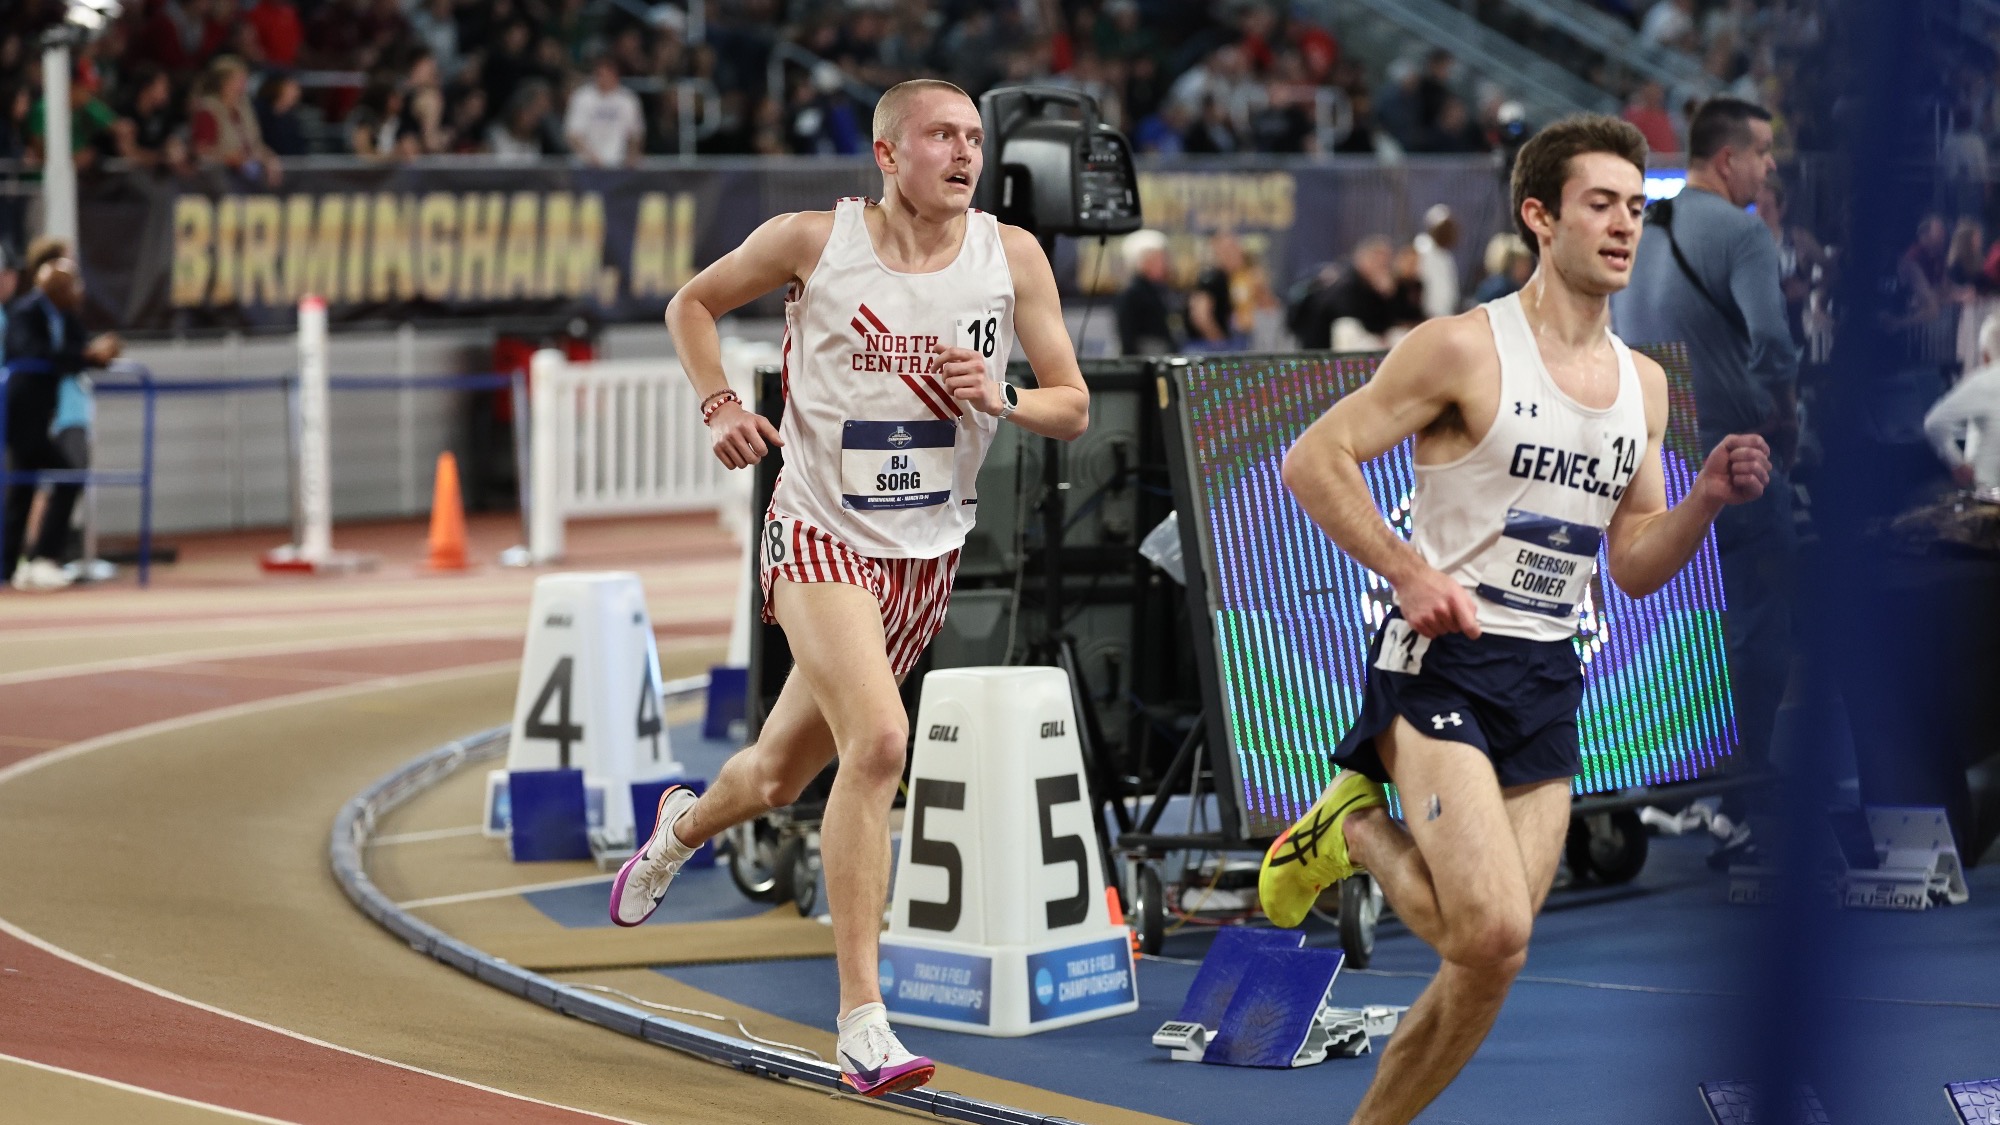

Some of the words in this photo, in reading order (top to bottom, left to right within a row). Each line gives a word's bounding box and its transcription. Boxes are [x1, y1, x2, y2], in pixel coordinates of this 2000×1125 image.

[172, 192, 620, 307] BIRMINGHAM,
[631, 189, 698, 299] AL
[865, 334, 939, 353] NORTH
[967, 317, 997, 358] 18
[891, 455, 908, 470] BJ
[1509, 443, 1626, 501] GENES
[1612, 436, 1636, 483] 14
[876, 471, 921, 491] SORG
[1515, 549, 1577, 576] EMERSON
[1511, 569, 1567, 598] COMER
[524, 655, 584, 768] 4
[637, 650, 662, 762] 4
[927, 724, 960, 743] GILL
[1040, 720, 1066, 739] GILL
[908, 777, 966, 933] 5
[1035, 773, 1090, 930] 5
[914, 963, 940, 981] TRACK
[949, 967, 972, 986] FIELD
[1067, 959, 1089, 978] TRACK
[1096, 953, 1116, 971] FIELD
[899, 980, 984, 1009] CHAMPIONSHIPS
[1058, 969, 1128, 1002] CHAMPIONSHIPS
[1162, 1024, 1195, 1032] GILL
